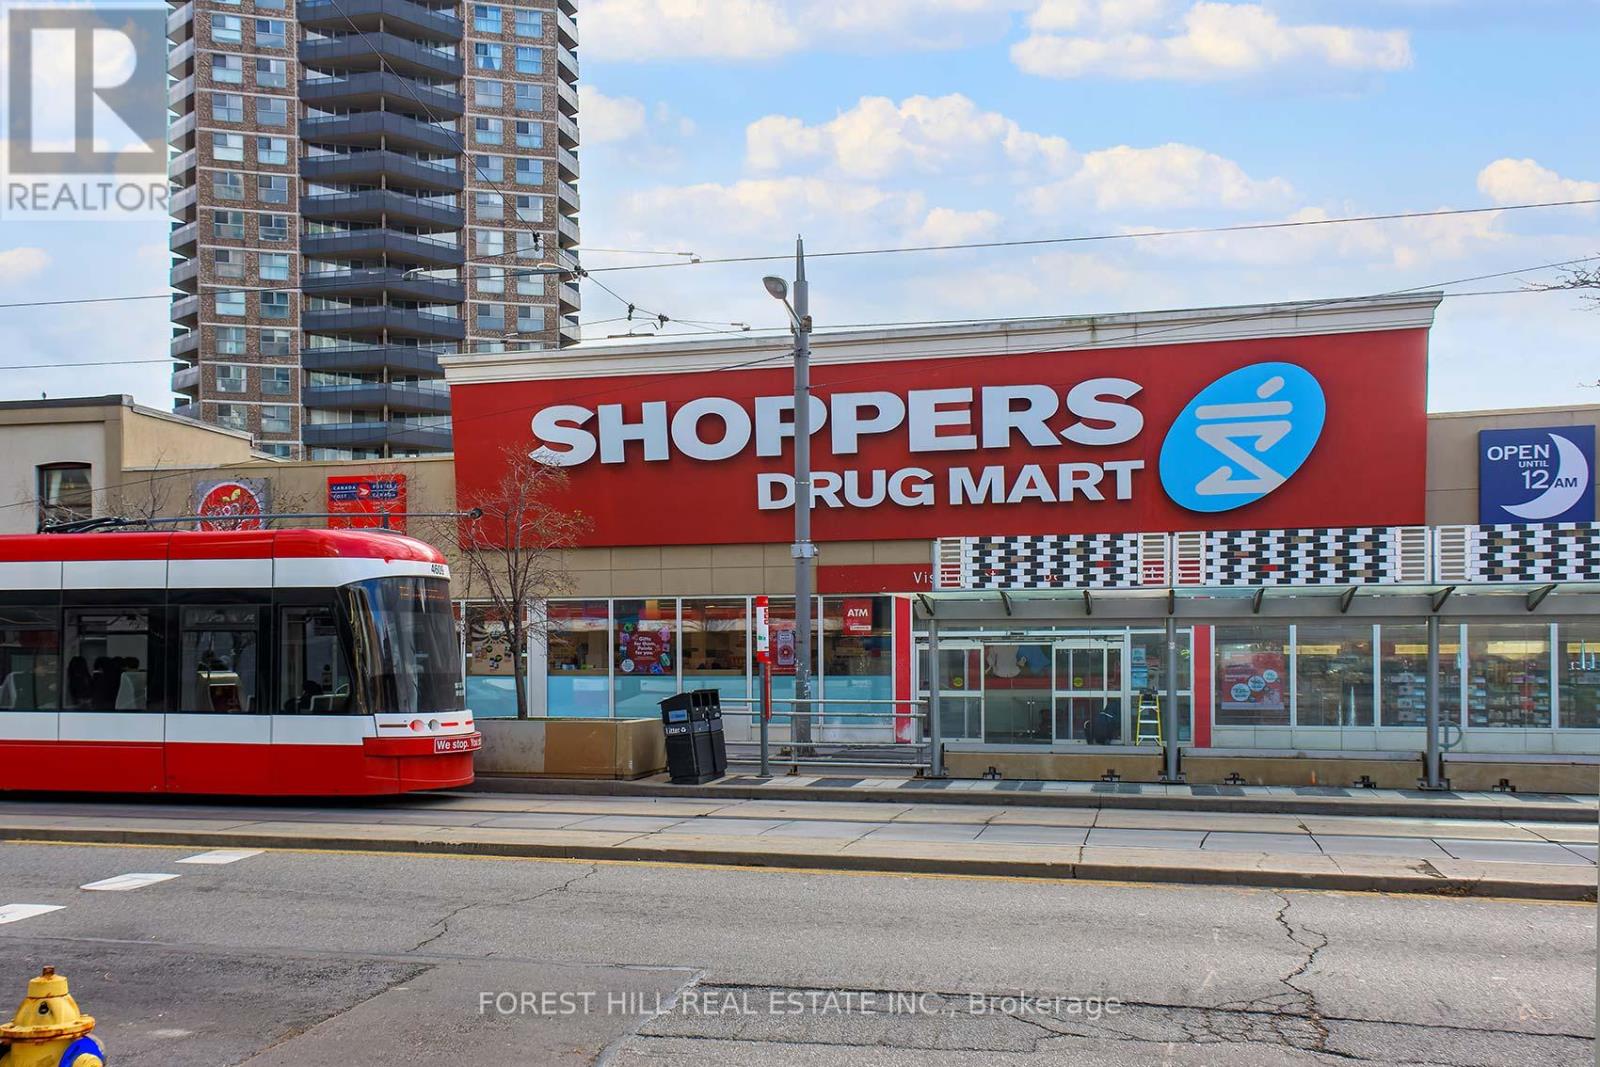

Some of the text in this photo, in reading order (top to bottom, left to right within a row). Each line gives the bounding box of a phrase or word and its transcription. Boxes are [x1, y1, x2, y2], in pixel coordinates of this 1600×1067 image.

[529, 377, 1144, 467] SHOPPERS
[1487, 444, 1549, 461] OPEN
[1518, 460, 1549, 468] UNTIL
[757, 460, 1145, 510] DRUG MART
[1521, 469, 1578, 490] 12 AM
[847, 608, 868, 617] ATM
[437, 740, 450, 750] We
[453, 740, 469, 750] stop.
